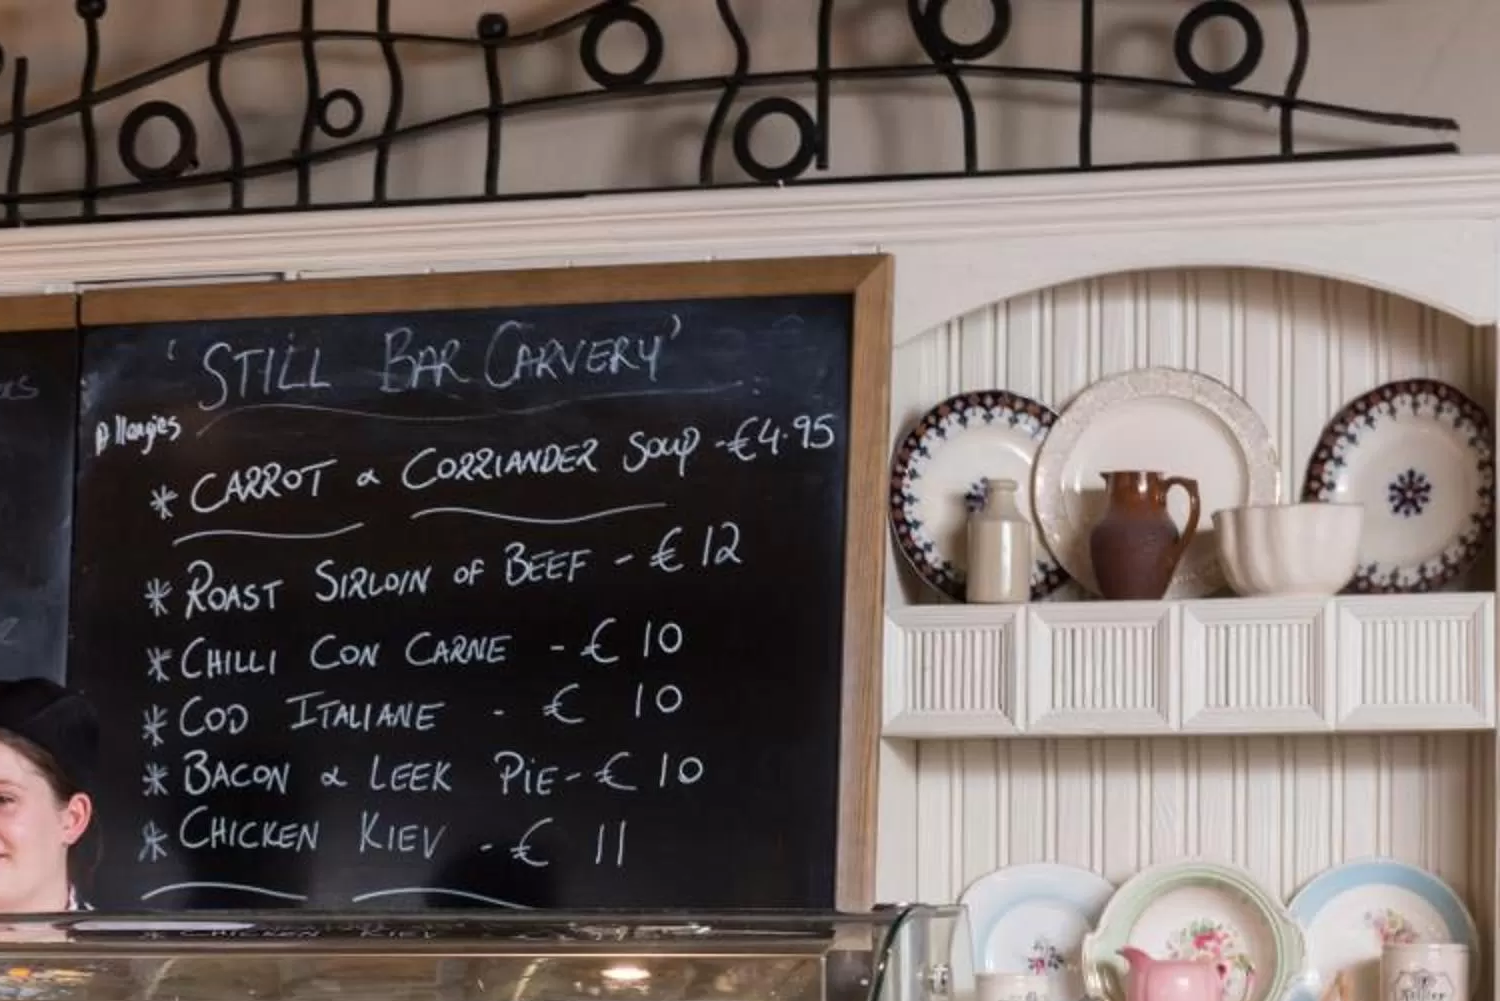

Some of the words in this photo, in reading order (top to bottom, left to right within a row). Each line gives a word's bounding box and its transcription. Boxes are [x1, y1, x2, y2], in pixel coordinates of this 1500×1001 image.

[381, 327, 469, 392] BAR
[191, 459, 338, 513] CARROT
[402, 438, 598, 490] CORRIANDER
[185, 559, 284, 620] ROAST
[315, 559, 432, 601] SIRLOIN
[504, 541, 592, 587] BEEF
[181, 637, 277, 679] CHILLI
[310, 634, 380, 670] CON
[405, 631, 513, 666] CARNE
[179, 696, 249, 737] COD
[285, 691, 446, 731] ITALIANE
[184, 749, 290, 796] BACON
[369, 753, 453, 792] LEEK
[179, 805, 320, 852] CHICKEN
[359, 811, 447, 860] KIEV
